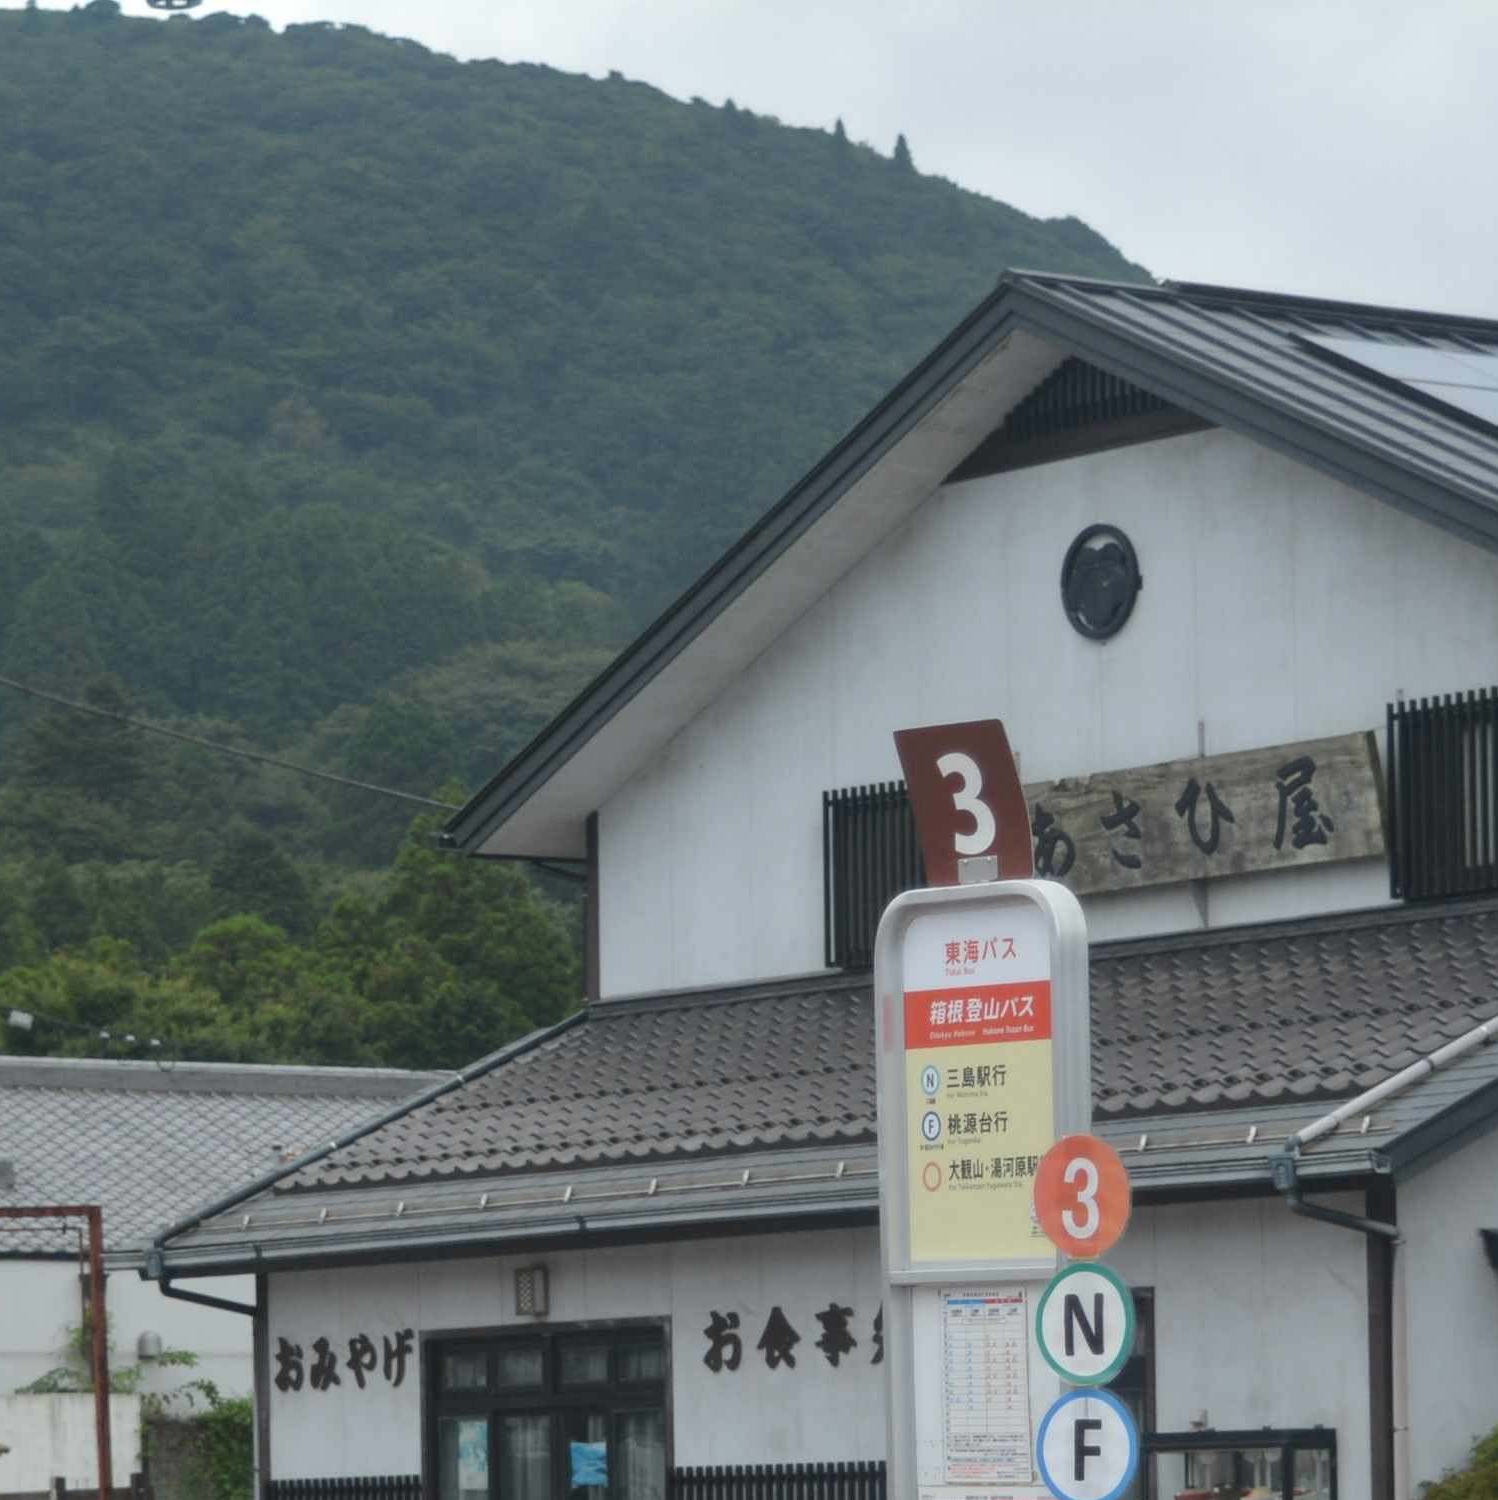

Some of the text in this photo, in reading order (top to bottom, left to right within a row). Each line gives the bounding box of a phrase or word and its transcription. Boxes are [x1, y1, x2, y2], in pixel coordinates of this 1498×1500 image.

[936, 752, 996, 855] 3
[1033, 756, 1334, 878] あさひ屋
[945, 936, 1016, 965] 東海バス
[945, 967, 974, 976] Tokai Bus
[930, 996, 1034, 1025] 箱根登山バス
[982, 1028, 1004, 1036] Hakone
[1023, 1024, 1034, 1032] Bus
[927, 1074, 935, 1088] N
[947, 1065, 1006, 1088] 三島駅行
[928, 1119, 934, 1134] F
[948, 1111, 1008, 1135] 桃源台行
[949, 1155, 1044, 1181] 大観山・湯河原駅
[1061, 1158, 1099, 1240] 3
[703, 1303, 884, 1373] お食事
[1064, 1293, 1105, 1356] N
[274, 1328, 413, 1392] おみやげ
[1074, 1419, 1102, 1481] F
